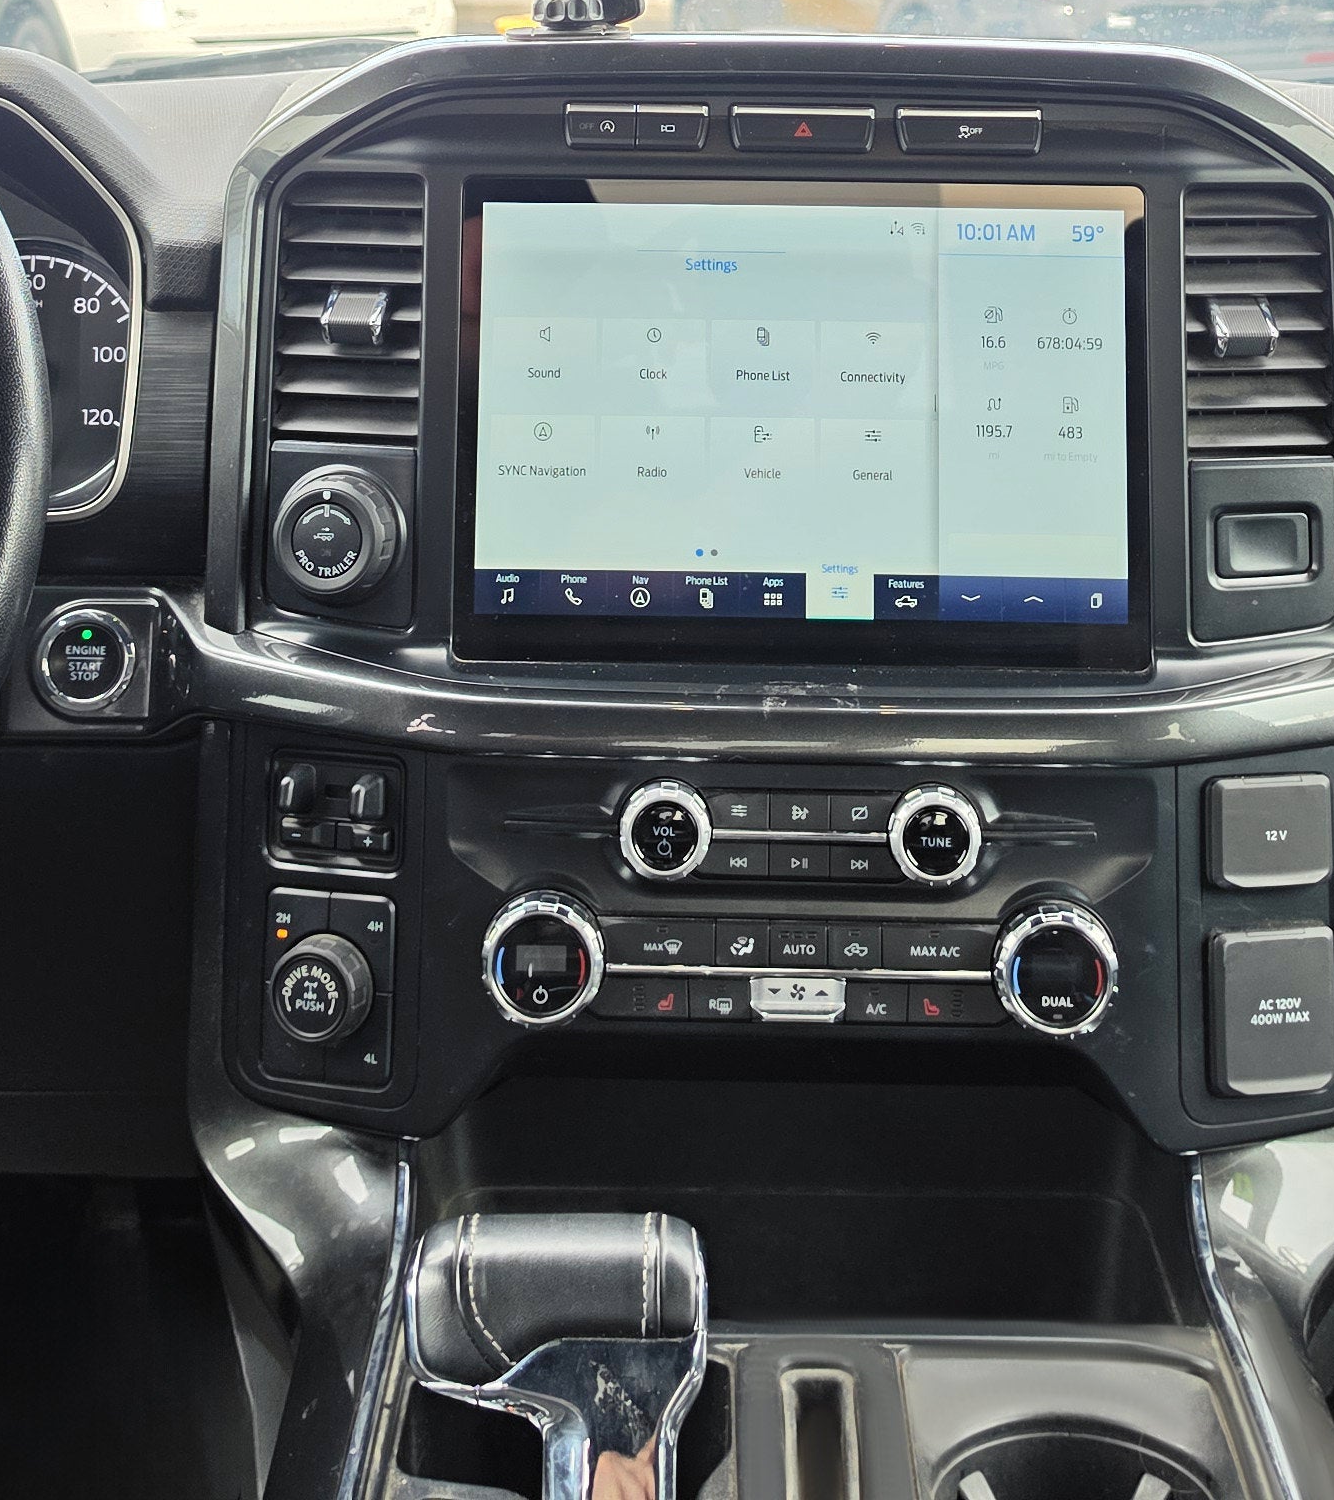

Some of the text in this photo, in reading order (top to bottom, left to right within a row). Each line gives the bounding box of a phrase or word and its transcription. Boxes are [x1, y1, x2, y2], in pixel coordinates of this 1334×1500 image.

[970, 128, 983, 136] OFF
[957, 223, 1035, 242] 10:01 AM
[1072, 225, 1105, 242] 59°
[685, 258, 738, 274] Settings
[74, 297, 100, 314] 80
[981, 336, 1006, 349] 16.6
[1037, 336, 1103, 350] 678:04:59
[92, 346, 127, 363] 100
[983, 361, 1005, 371] MPG
[527, 366, 561, 379] Sound
[639, 368, 667, 380] Clock
[735, 370, 791, 382] Phone List
[840, 371, 906, 385] Connectivity
[82, 408, 114, 426] 120
[975, 424, 1013, 438] 1195.7
[1058, 426, 1083, 440] 483
[988, 451, 1000, 460] mi
[1068, 452, 1099, 464] Empty
[498, 464, 587, 479] SYNC Navigation
[637, 466, 667, 478] Radio
[744, 468, 781, 480] Vehicle
[853, 470, 893, 481] General
[295, 550, 358, 578] PRO TRAILER
[821, 563, 859, 576] Settings
[495, 574, 520, 583] Audio
[561, 574, 588, 584] Phone
[632, 575, 649, 585] Nav
[685, 576, 729, 586] Phone List
[763, 577, 785, 588] Apps
[888, 578, 925, 590] Features
[65, 645, 107, 656] ENGINE
[68, 662, 102, 672] START
[69, 672, 100, 681] STOP
[652, 826, 676, 837] VOL
[921, 836, 953, 848] TUNE
[275, 912, 292, 924] 2H
[367, 920, 384, 932] 4H
[643, 943, 664, 952] MAX
[783, 944, 817, 956] AUTO
[910, 946, 961, 958] MAX A/C
[281, 964, 339, 1000] DRIVE MODE
[295, 999, 325, 1012] PUSH
[1041, 996, 1074, 1008] DUAL
[1259, 998, 1301, 1010] AC 120V
[865, 1003, 887, 1016] A/C
[1251, 1011, 1311, 1026] 400W MAX
[363, 1052, 378, 1064] 4L
